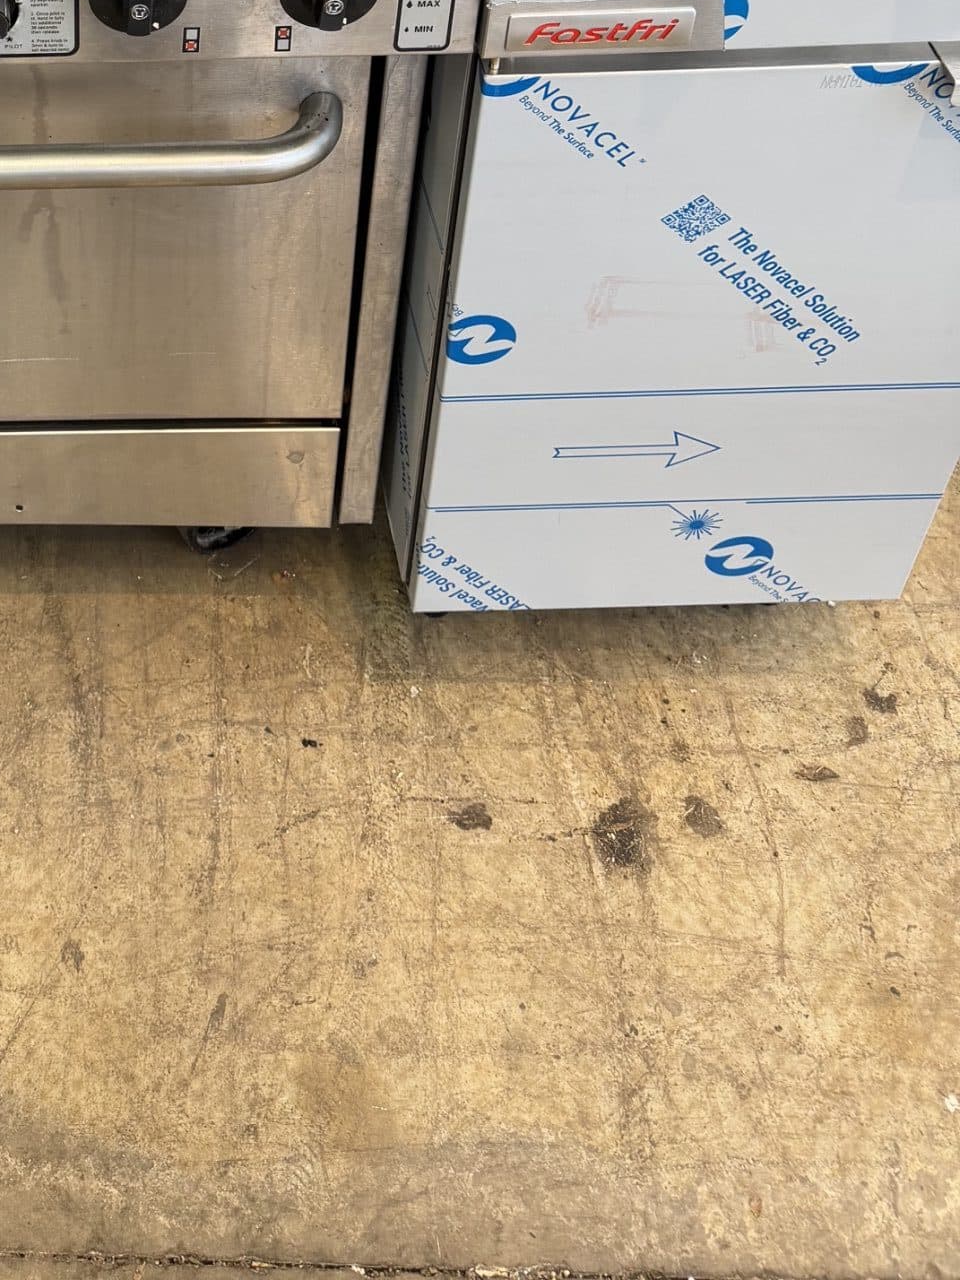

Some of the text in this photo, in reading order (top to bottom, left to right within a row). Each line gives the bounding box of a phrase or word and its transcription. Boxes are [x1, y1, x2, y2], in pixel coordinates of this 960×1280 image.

[417, 0, 441, 8] MAX
[523, 18, 679, 45] Fastfri
[519, 95, 595, 159] Beyond The Surface
[533, 80, 636, 167] NOVACEL
[903, 82, 934, 109] Beyond
[929, 105, 945, 122] The
[697, 245, 725, 266] for
[718, 262, 772, 305] LASER
[762, 299, 803, 331] Fiber
[796, 327, 816, 342] &
[728, 227, 860, 342] The Novacel Solution
[454, 564, 490, 589] Fiber
